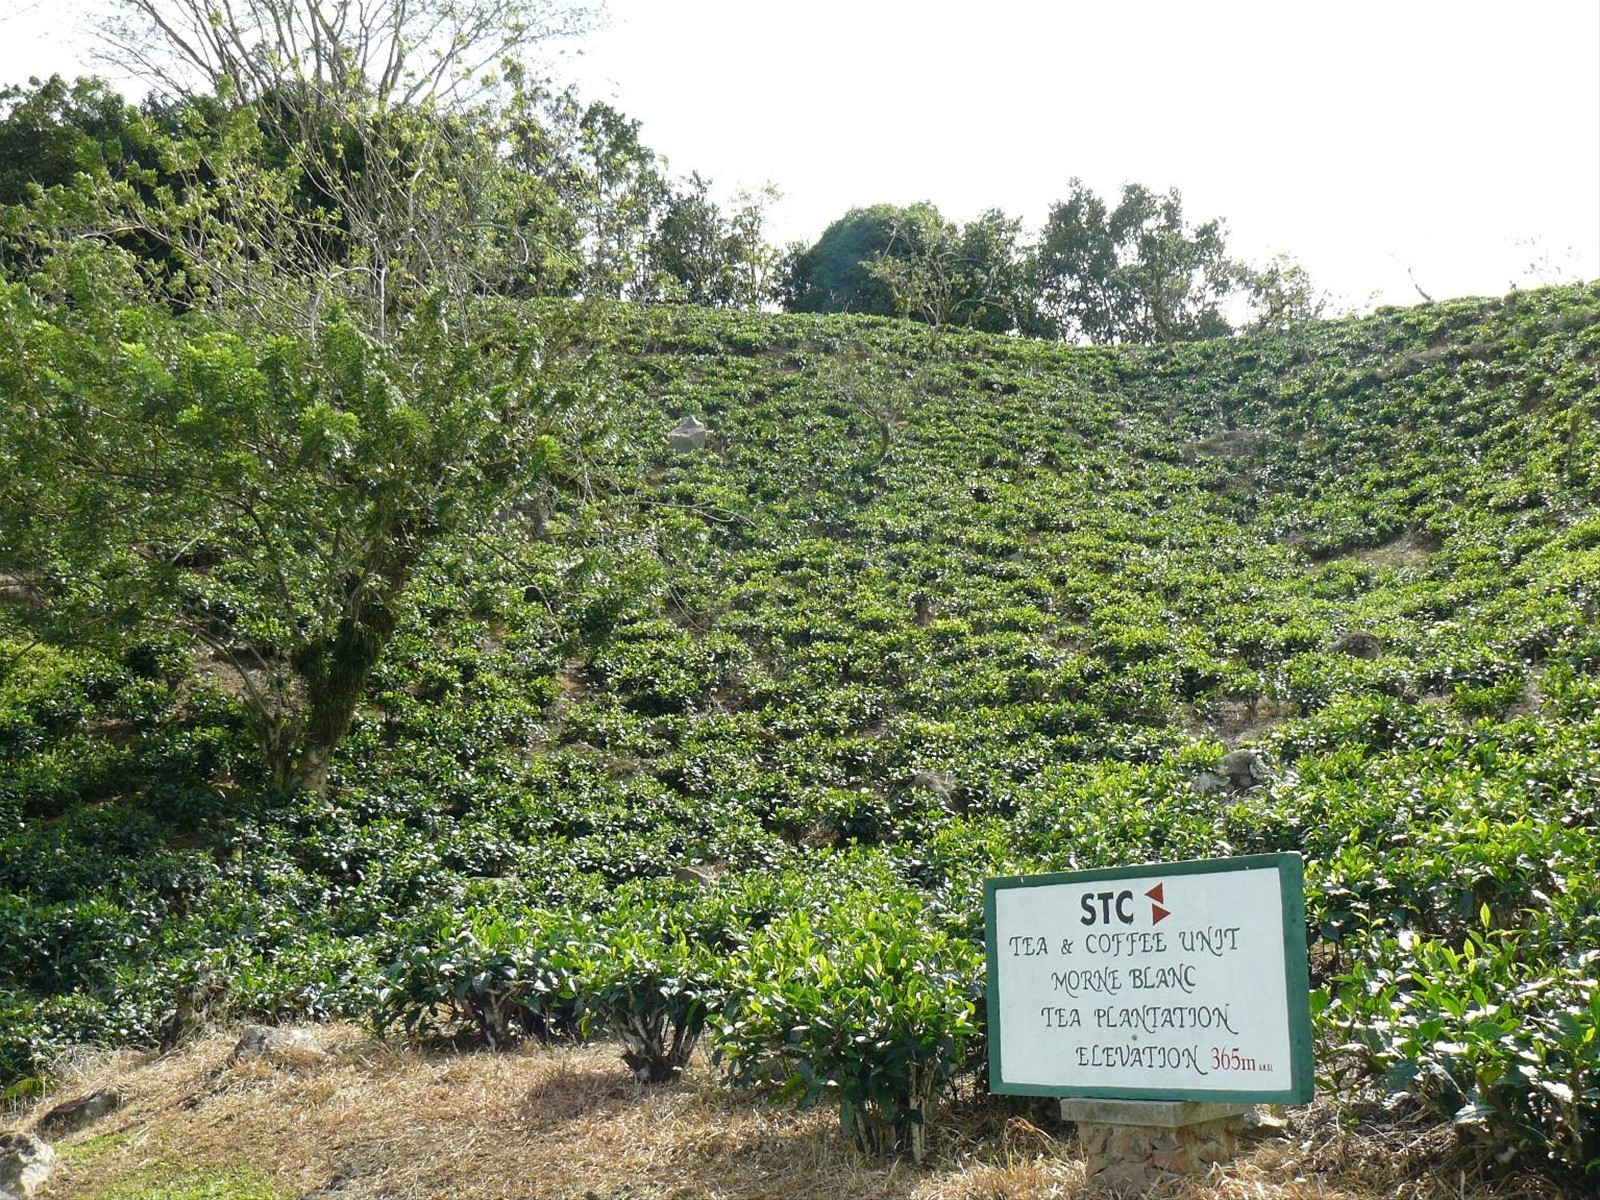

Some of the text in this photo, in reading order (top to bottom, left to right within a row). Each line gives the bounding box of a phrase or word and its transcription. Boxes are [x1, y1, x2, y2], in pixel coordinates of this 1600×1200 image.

[1080, 890, 1134, 926] STC
[1009, 926, 1241, 957] TEA & COFFEE UNIT
[1051, 963, 1197, 998] MORNE BLANC
[1041, 1003, 1239, 1035] TEA PLANTATION
[1075, 1044, 1256, 1076] ELEVATION 365m
